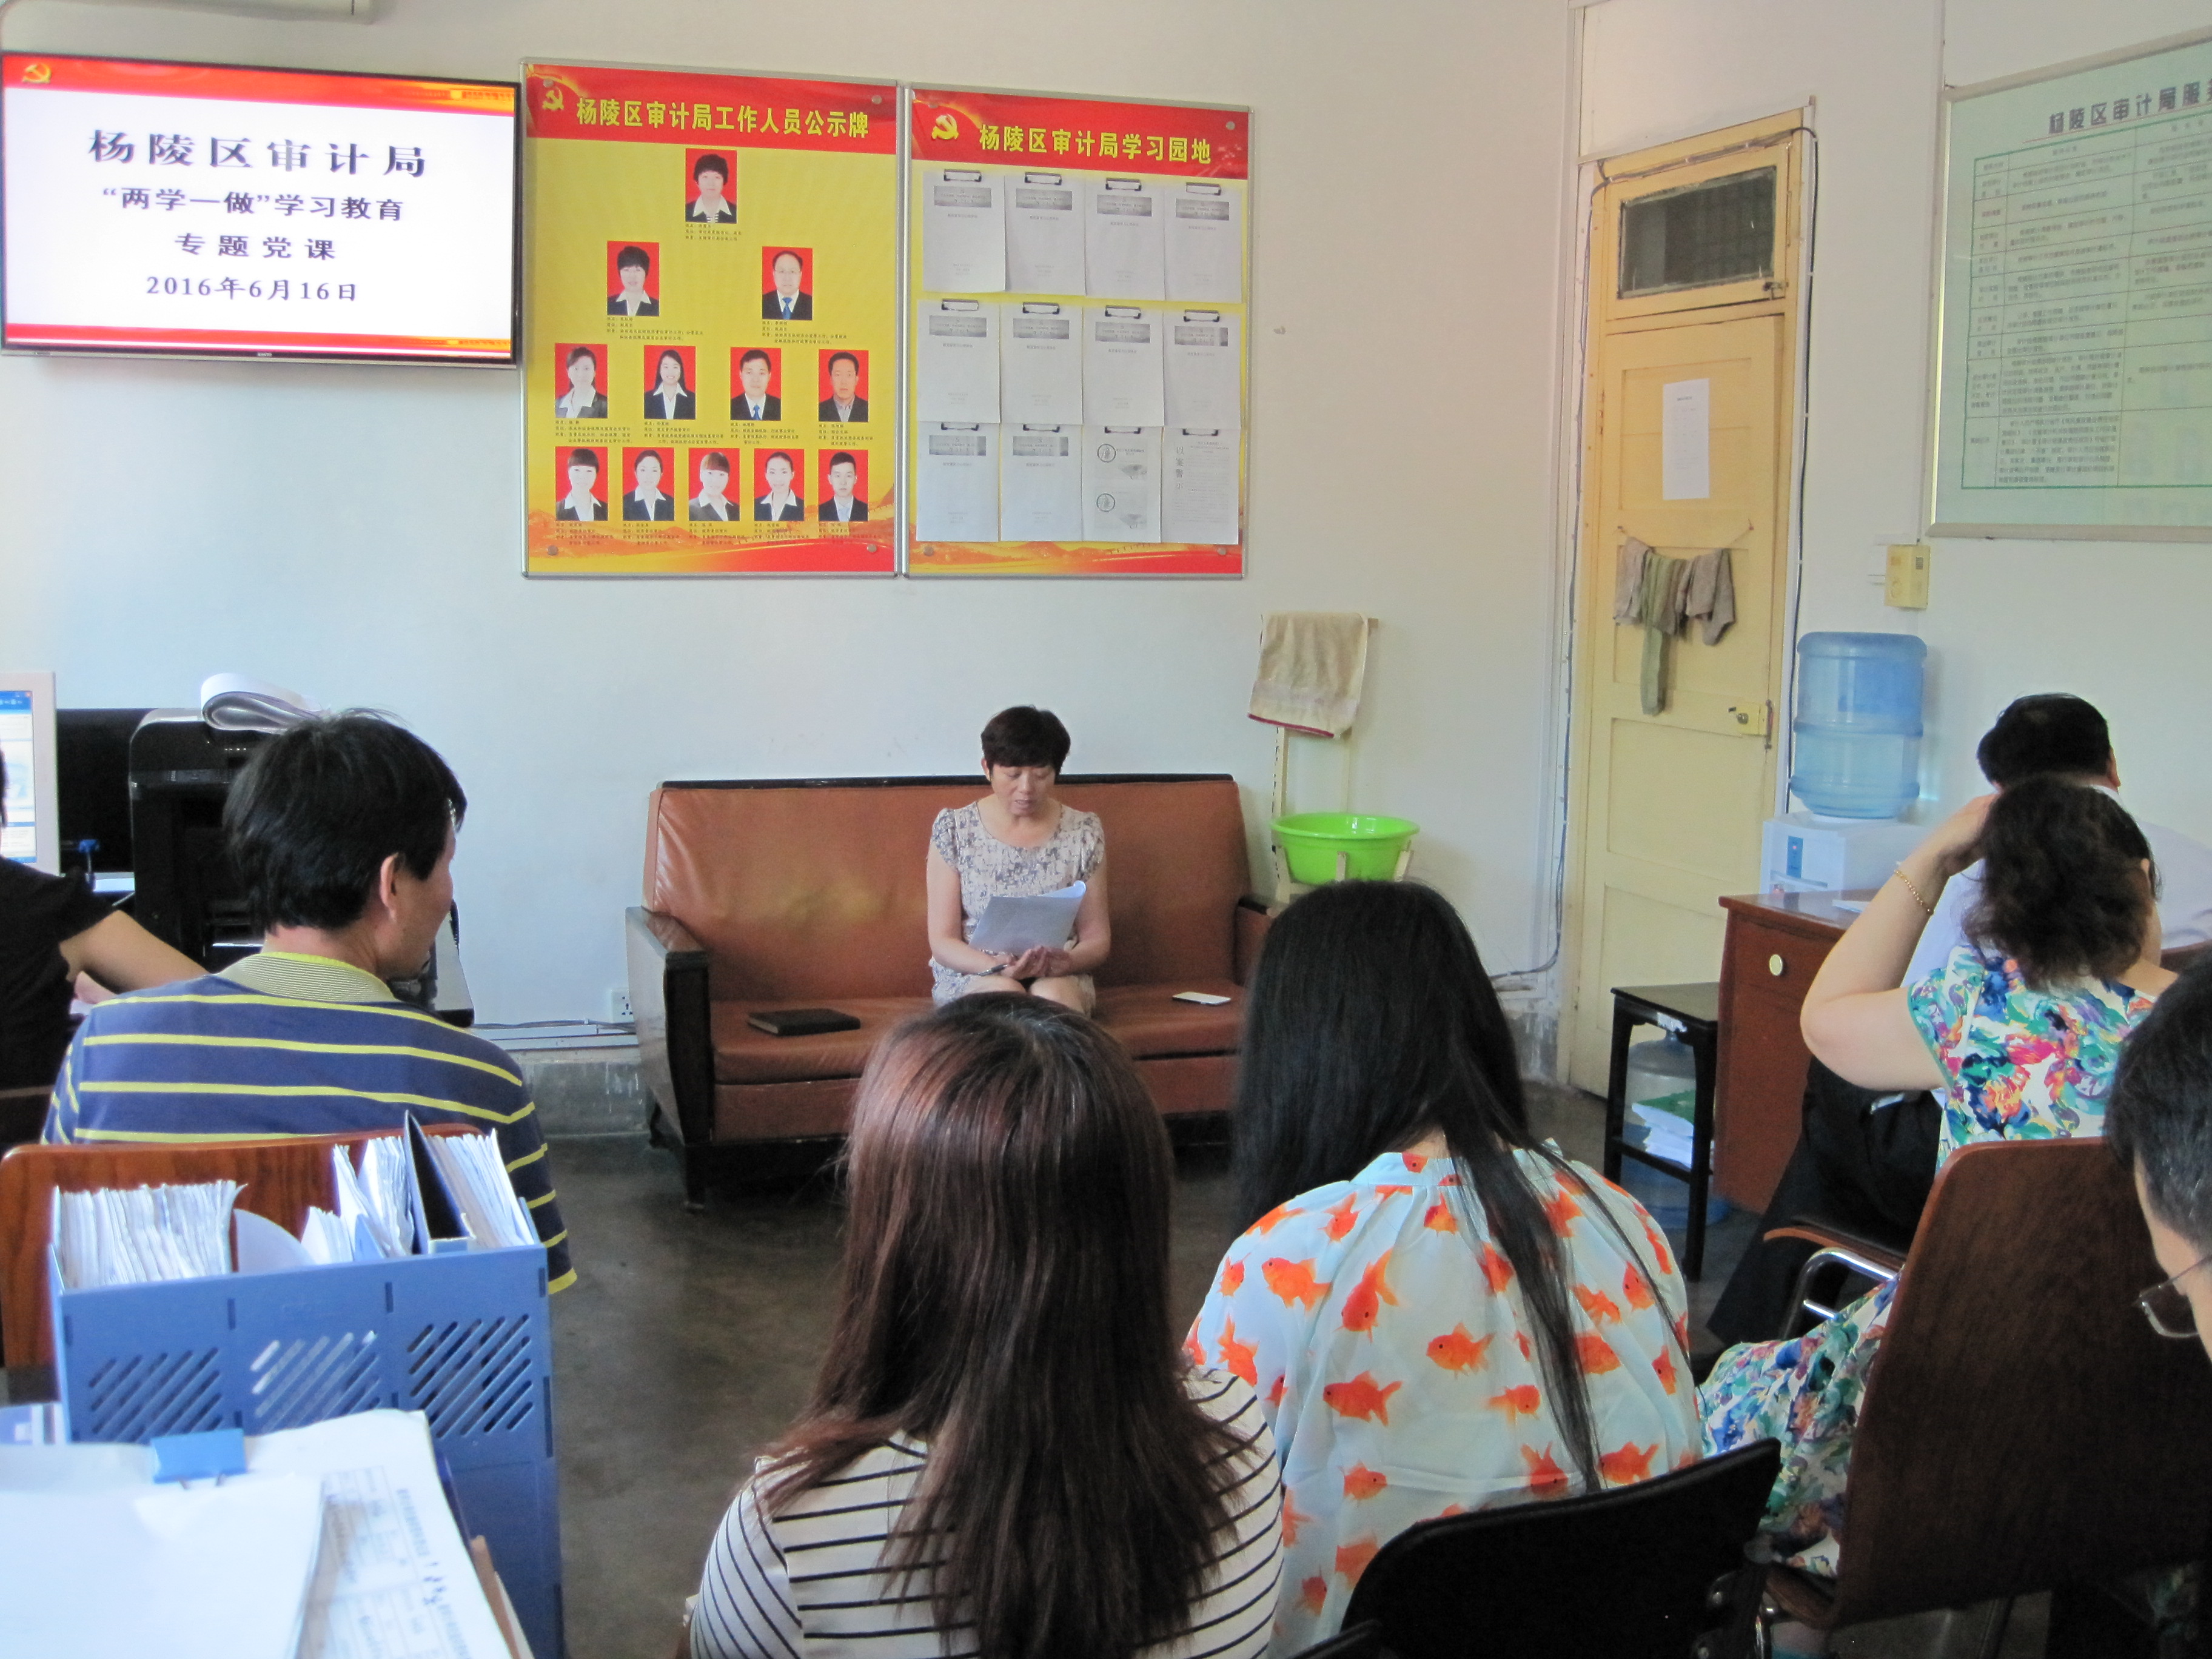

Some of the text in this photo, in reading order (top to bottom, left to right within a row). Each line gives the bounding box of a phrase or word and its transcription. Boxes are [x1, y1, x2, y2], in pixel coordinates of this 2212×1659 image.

[577, 98, 869, 138] 杨陵区审计局工作人员公示牌
[89, 129, 426, 178] 杨陵区审计局
[979, 124, 1212, 165] 杨陵区审计局学习园地
[102, 187, 403, 221] “两学一做”学习教育
[175, 233, 335, 261] 专题党课
[146, 276, 357, 302] 2016年6月16日
